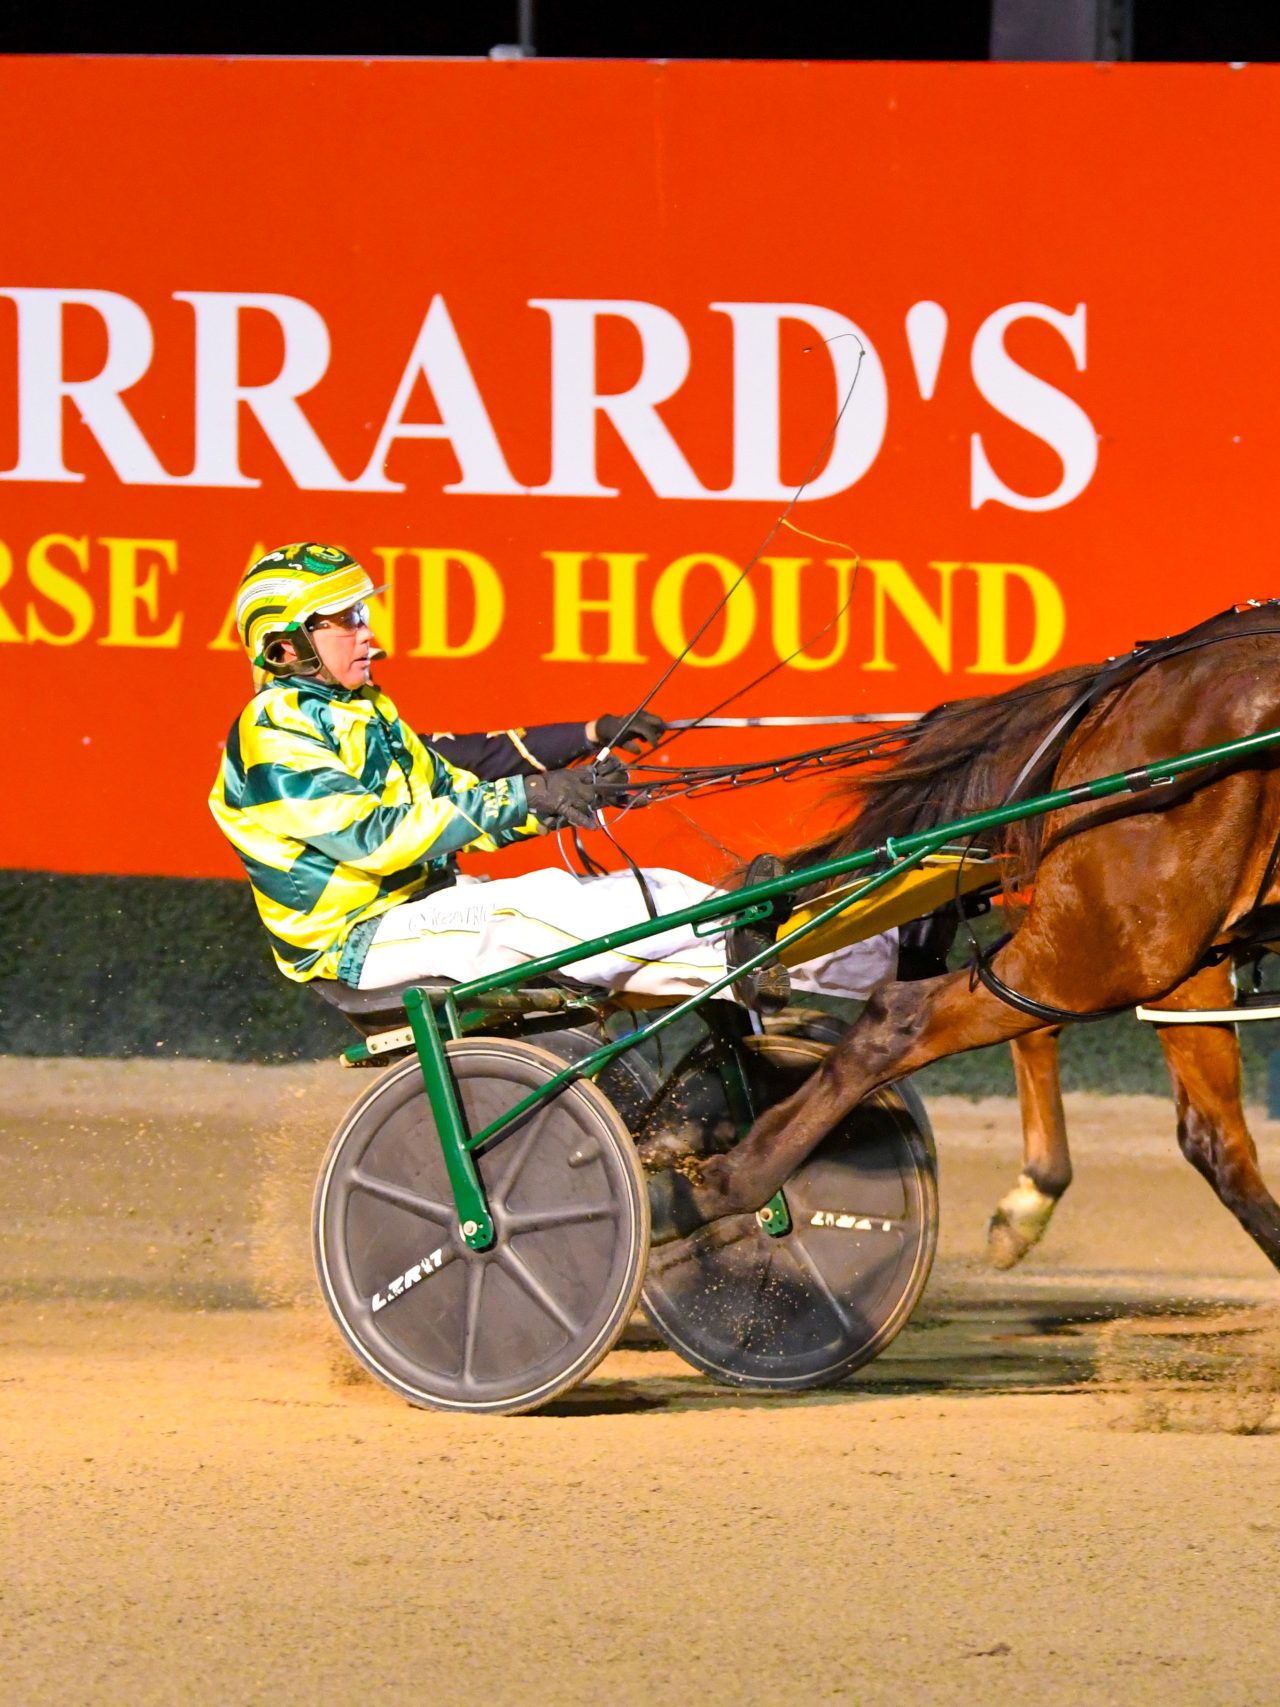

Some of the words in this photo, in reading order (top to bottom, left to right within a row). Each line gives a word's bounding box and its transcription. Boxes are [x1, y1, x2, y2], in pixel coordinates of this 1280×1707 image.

[0, 286, 1099, 512] RRARD'S
[0, 532, 184, 649] SE
[541, 551, 1067, 676] HOUND
